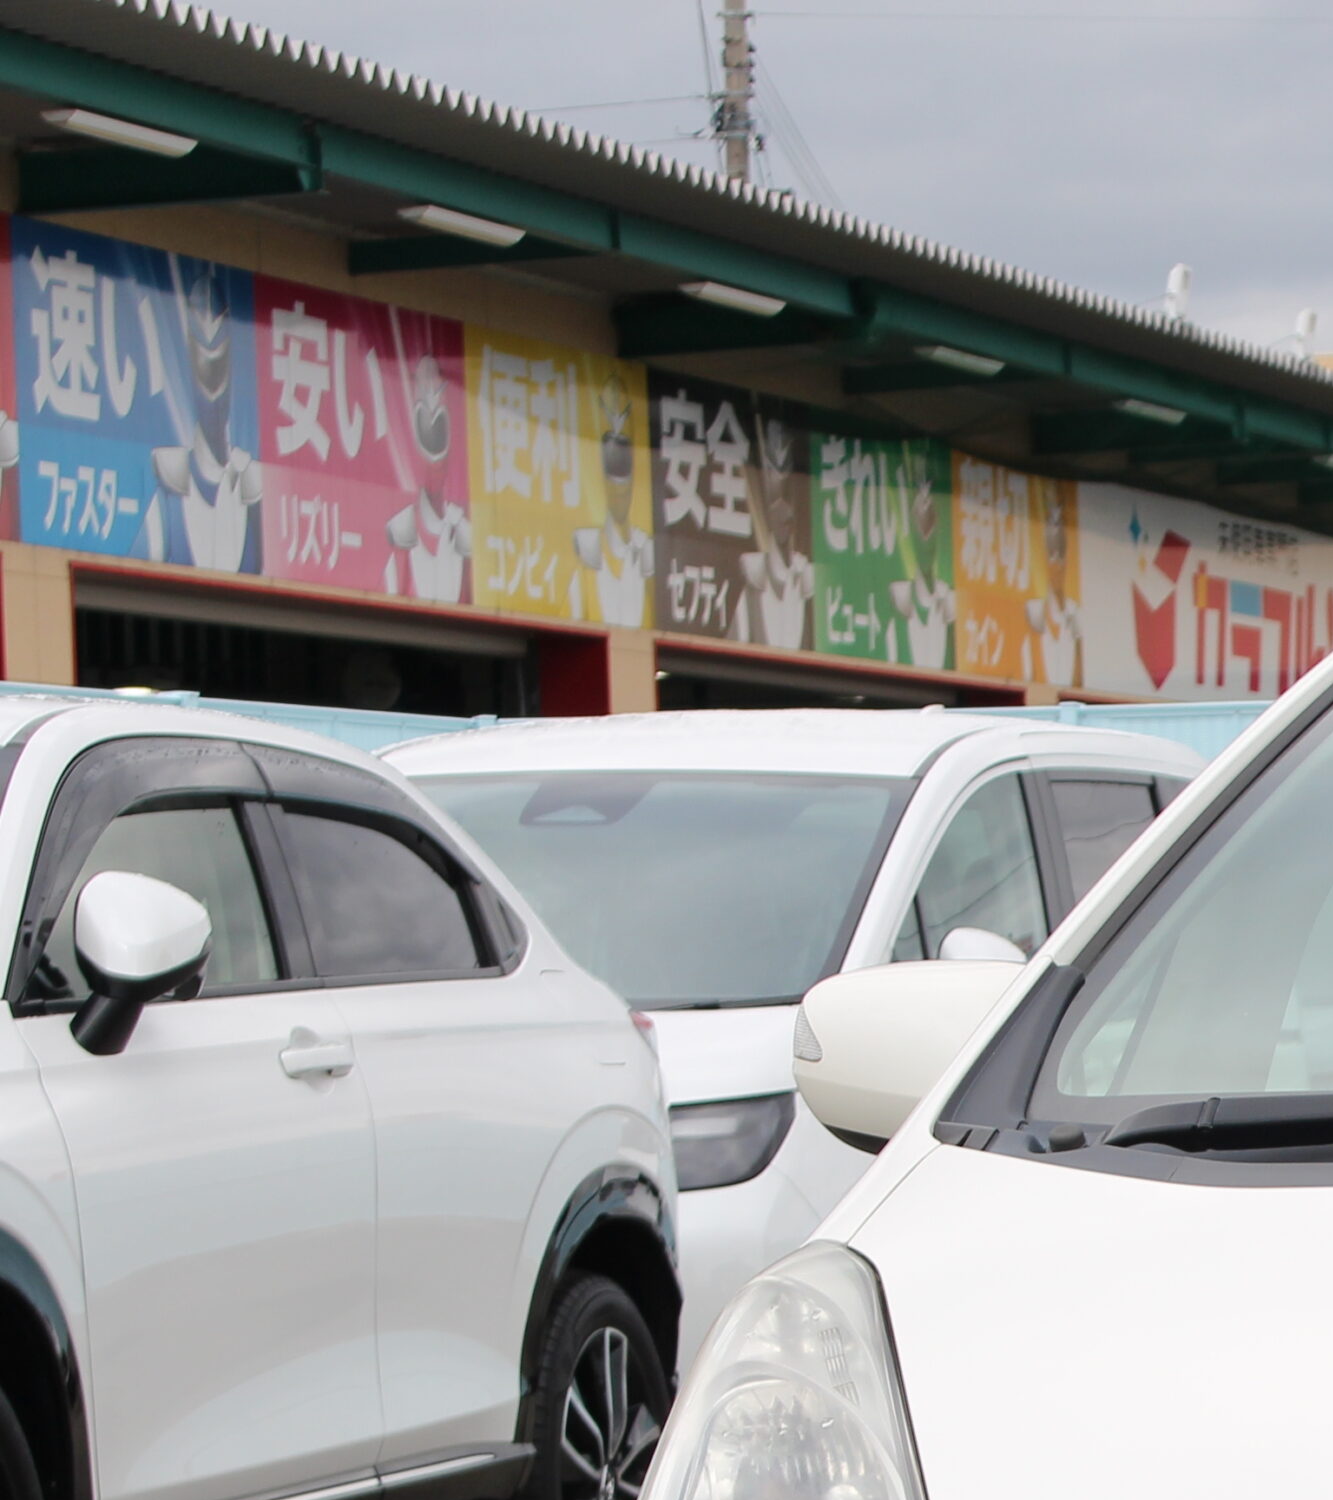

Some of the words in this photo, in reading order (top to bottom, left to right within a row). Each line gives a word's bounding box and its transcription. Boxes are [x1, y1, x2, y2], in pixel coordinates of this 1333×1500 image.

[31, 246, 164, 422] 速い
[271, 301, 388, 462] 安い
[38, 460, 140, 541] ファスター
[479, 343, 581, 508] 便利
[661, 389, 751, 538] 安全
[820, 434, 910, 556] きれい
